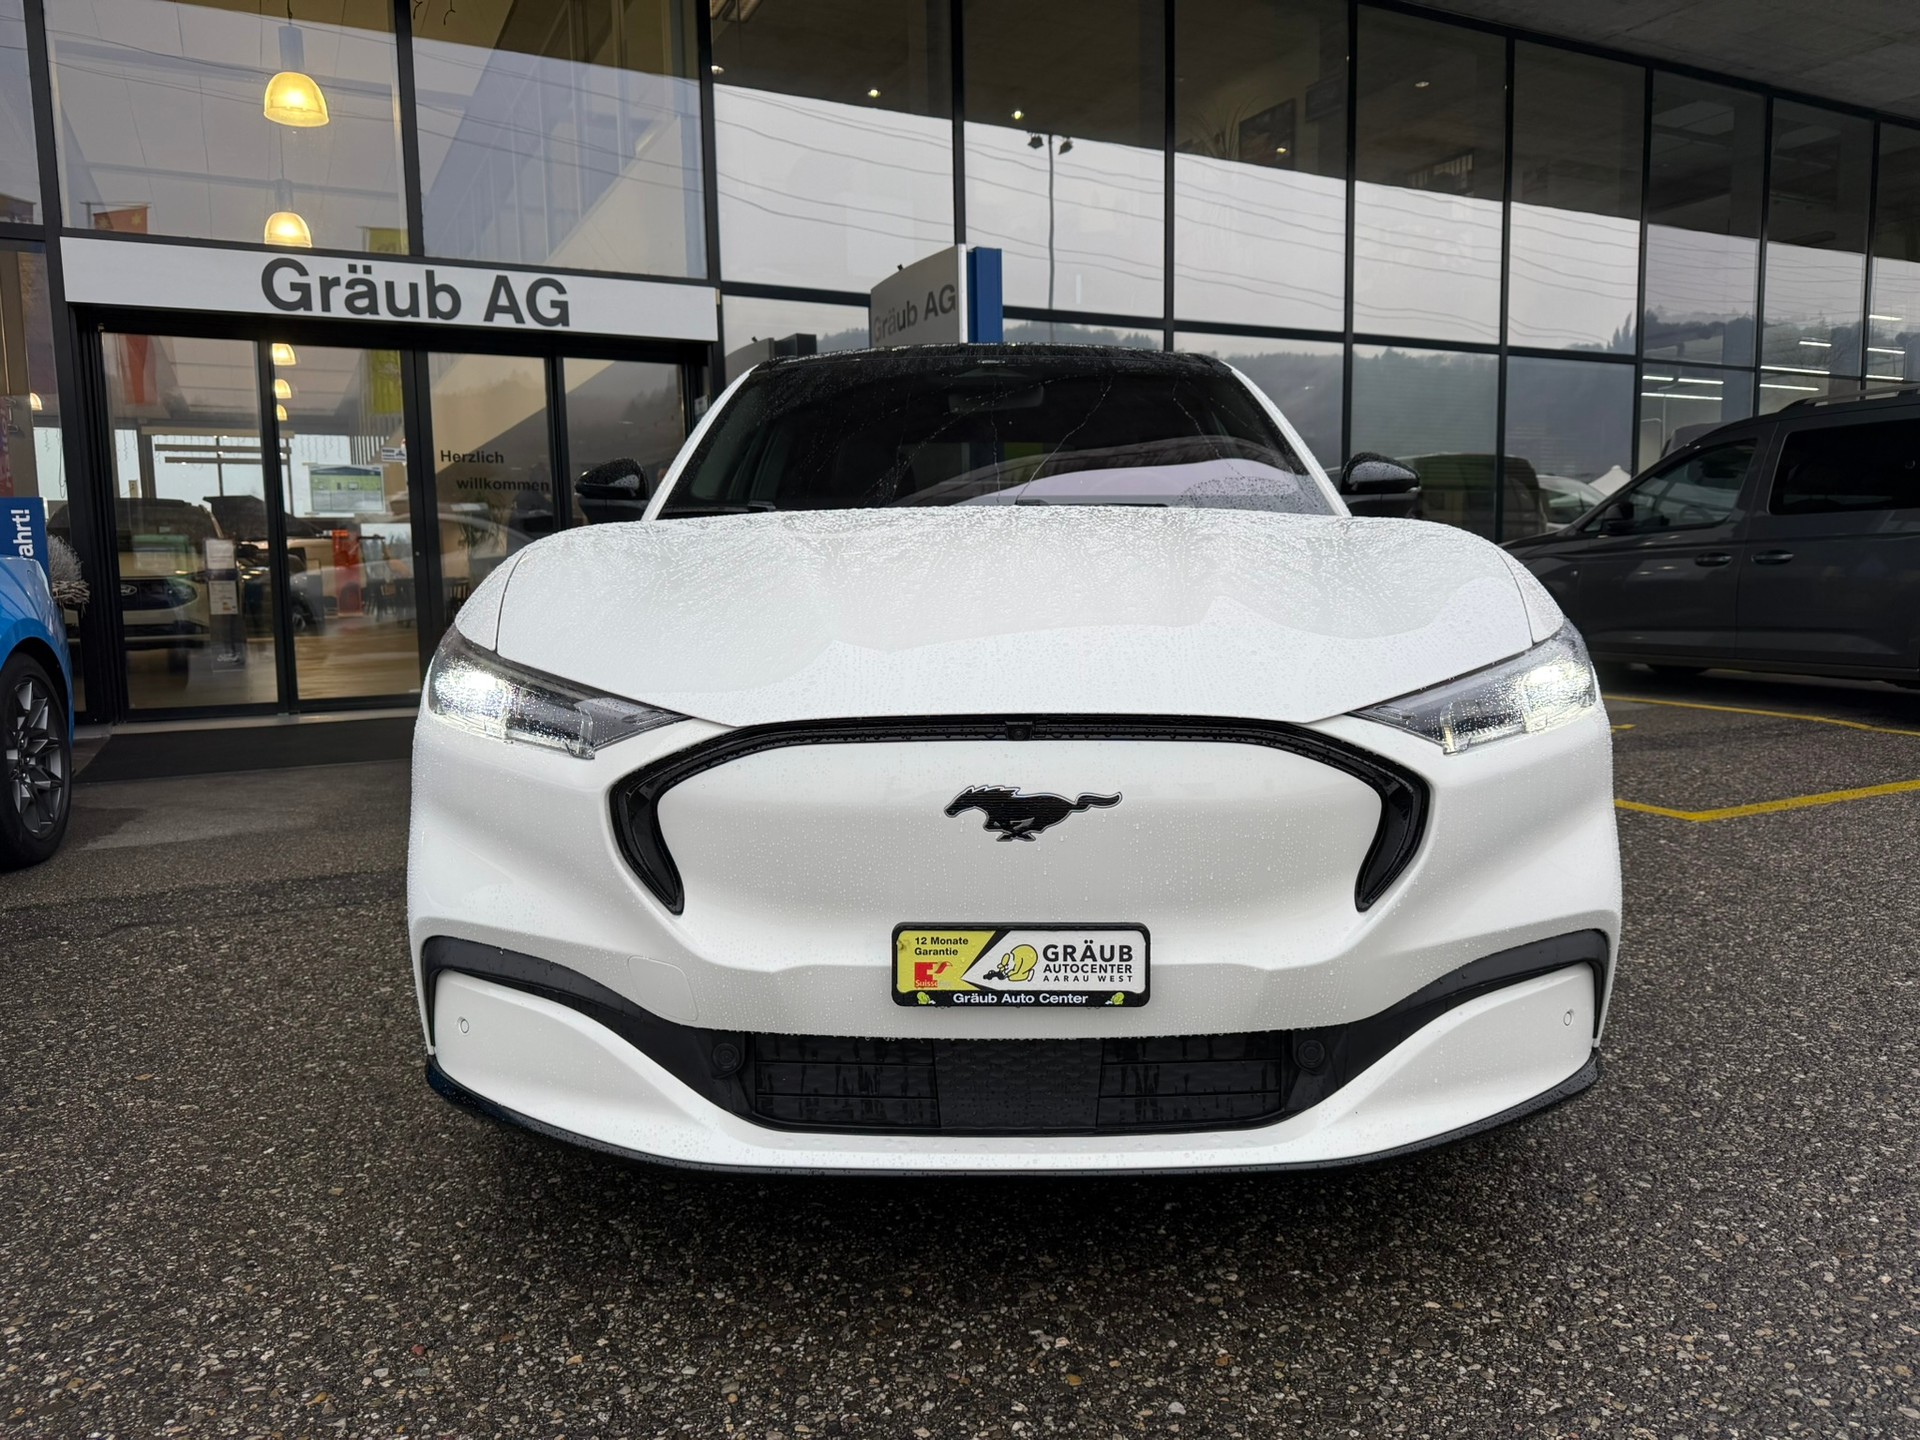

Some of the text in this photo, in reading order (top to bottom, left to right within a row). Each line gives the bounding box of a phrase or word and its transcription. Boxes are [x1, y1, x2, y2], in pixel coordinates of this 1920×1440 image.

[261, 257, 570, 327] Gräub AG
[874, 284, 956, 343] Gräub AG
[440, 450, 504, 464] Herzlich
[456, 477, 550, 492] willkommen
[10, 509, 34, 558] ahrt!
[915, 936, 969, 945] 12 Monate
[914, 947, 959, 956] Garantie
[1042, 939, 1134, 963] GRÄUB
[1043, 964, 1133, 974] AUTOCENTER
[1043, 975, 1133, 983] AARAU WEST
[952, 992, 1089, 1004] Gräub Auto Center
